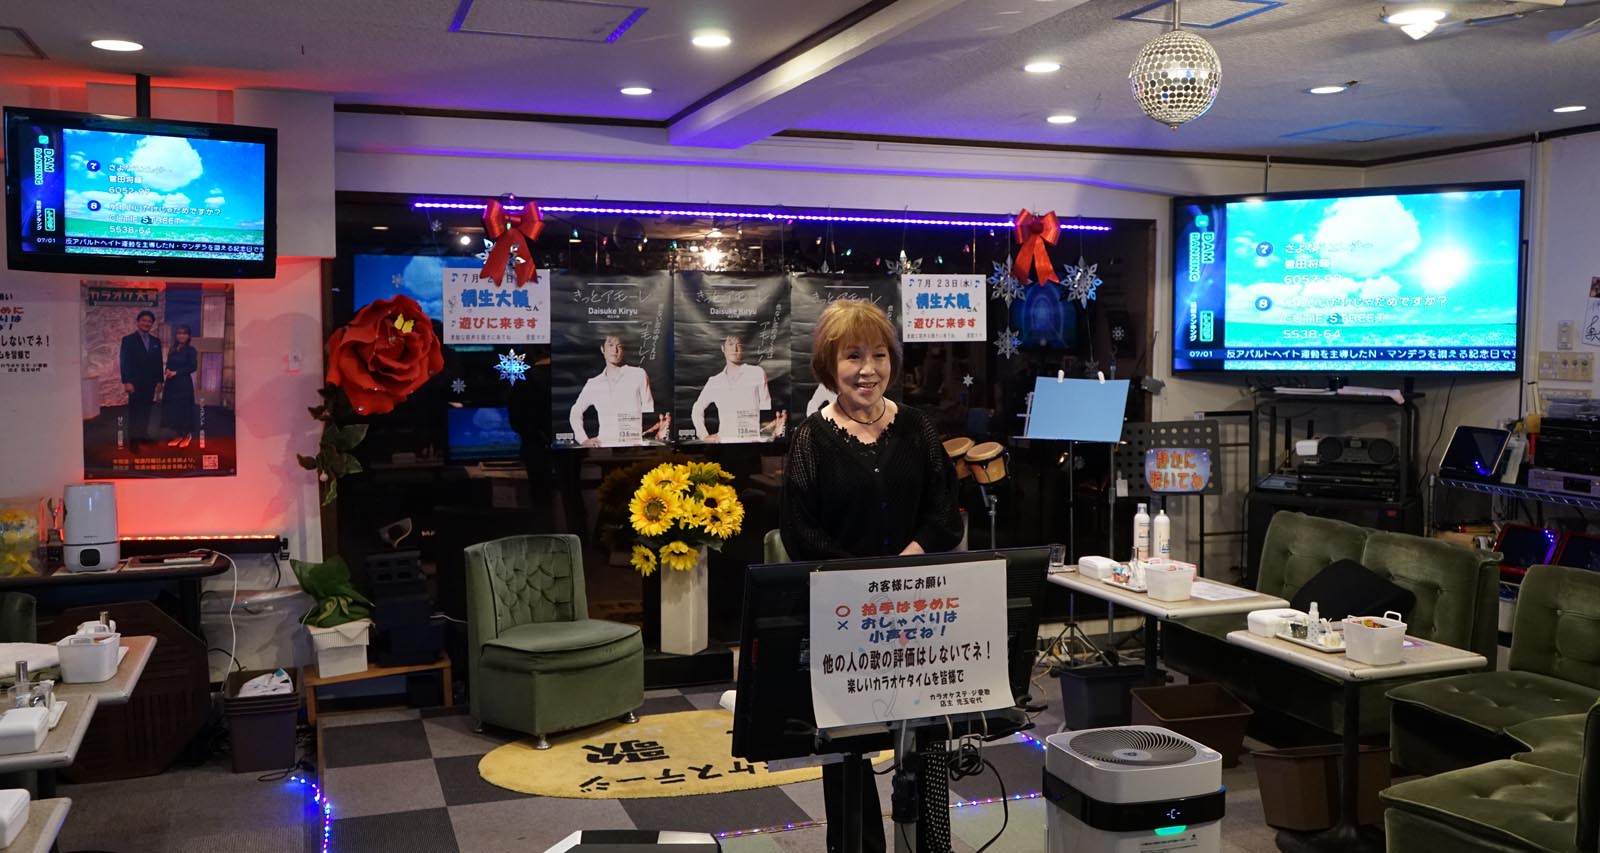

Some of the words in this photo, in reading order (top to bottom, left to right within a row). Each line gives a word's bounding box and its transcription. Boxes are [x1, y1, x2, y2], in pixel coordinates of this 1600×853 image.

[34, 148, 43, 185] RANKING
[44, 149, 55, 172] DAM
[1190, 232, 1200, 281] RANKING
[1202, 232, 1215, 264] DAM
[573, 289, 651, 304] きっとアモーレ
[588, 307, 617, 315] Daisuke
[618, 307, 638, 317] Kiryu
[710, 307, 739, 315] Daisuke
[459, 317, 538, 330] 遊びに来ます
[914, 317, 976, 330] 遊びに来ます
[1189, 350, 1213, 358] 07/01
[868, 576, 947, 593] お客様にお願い
[861, 597, 960, 617] 拍手は多めに
[861, 610, 957, 630] おしゃべりは
[869, 625, 946, 643] 小声でね！
[823, 640, 991, 675] 他の人の歌の評価はしないでネ！
[847, 669, 965, 694] 楽しいカラオケタイムを皆様で
[581, 739, 670, 765] 歌
